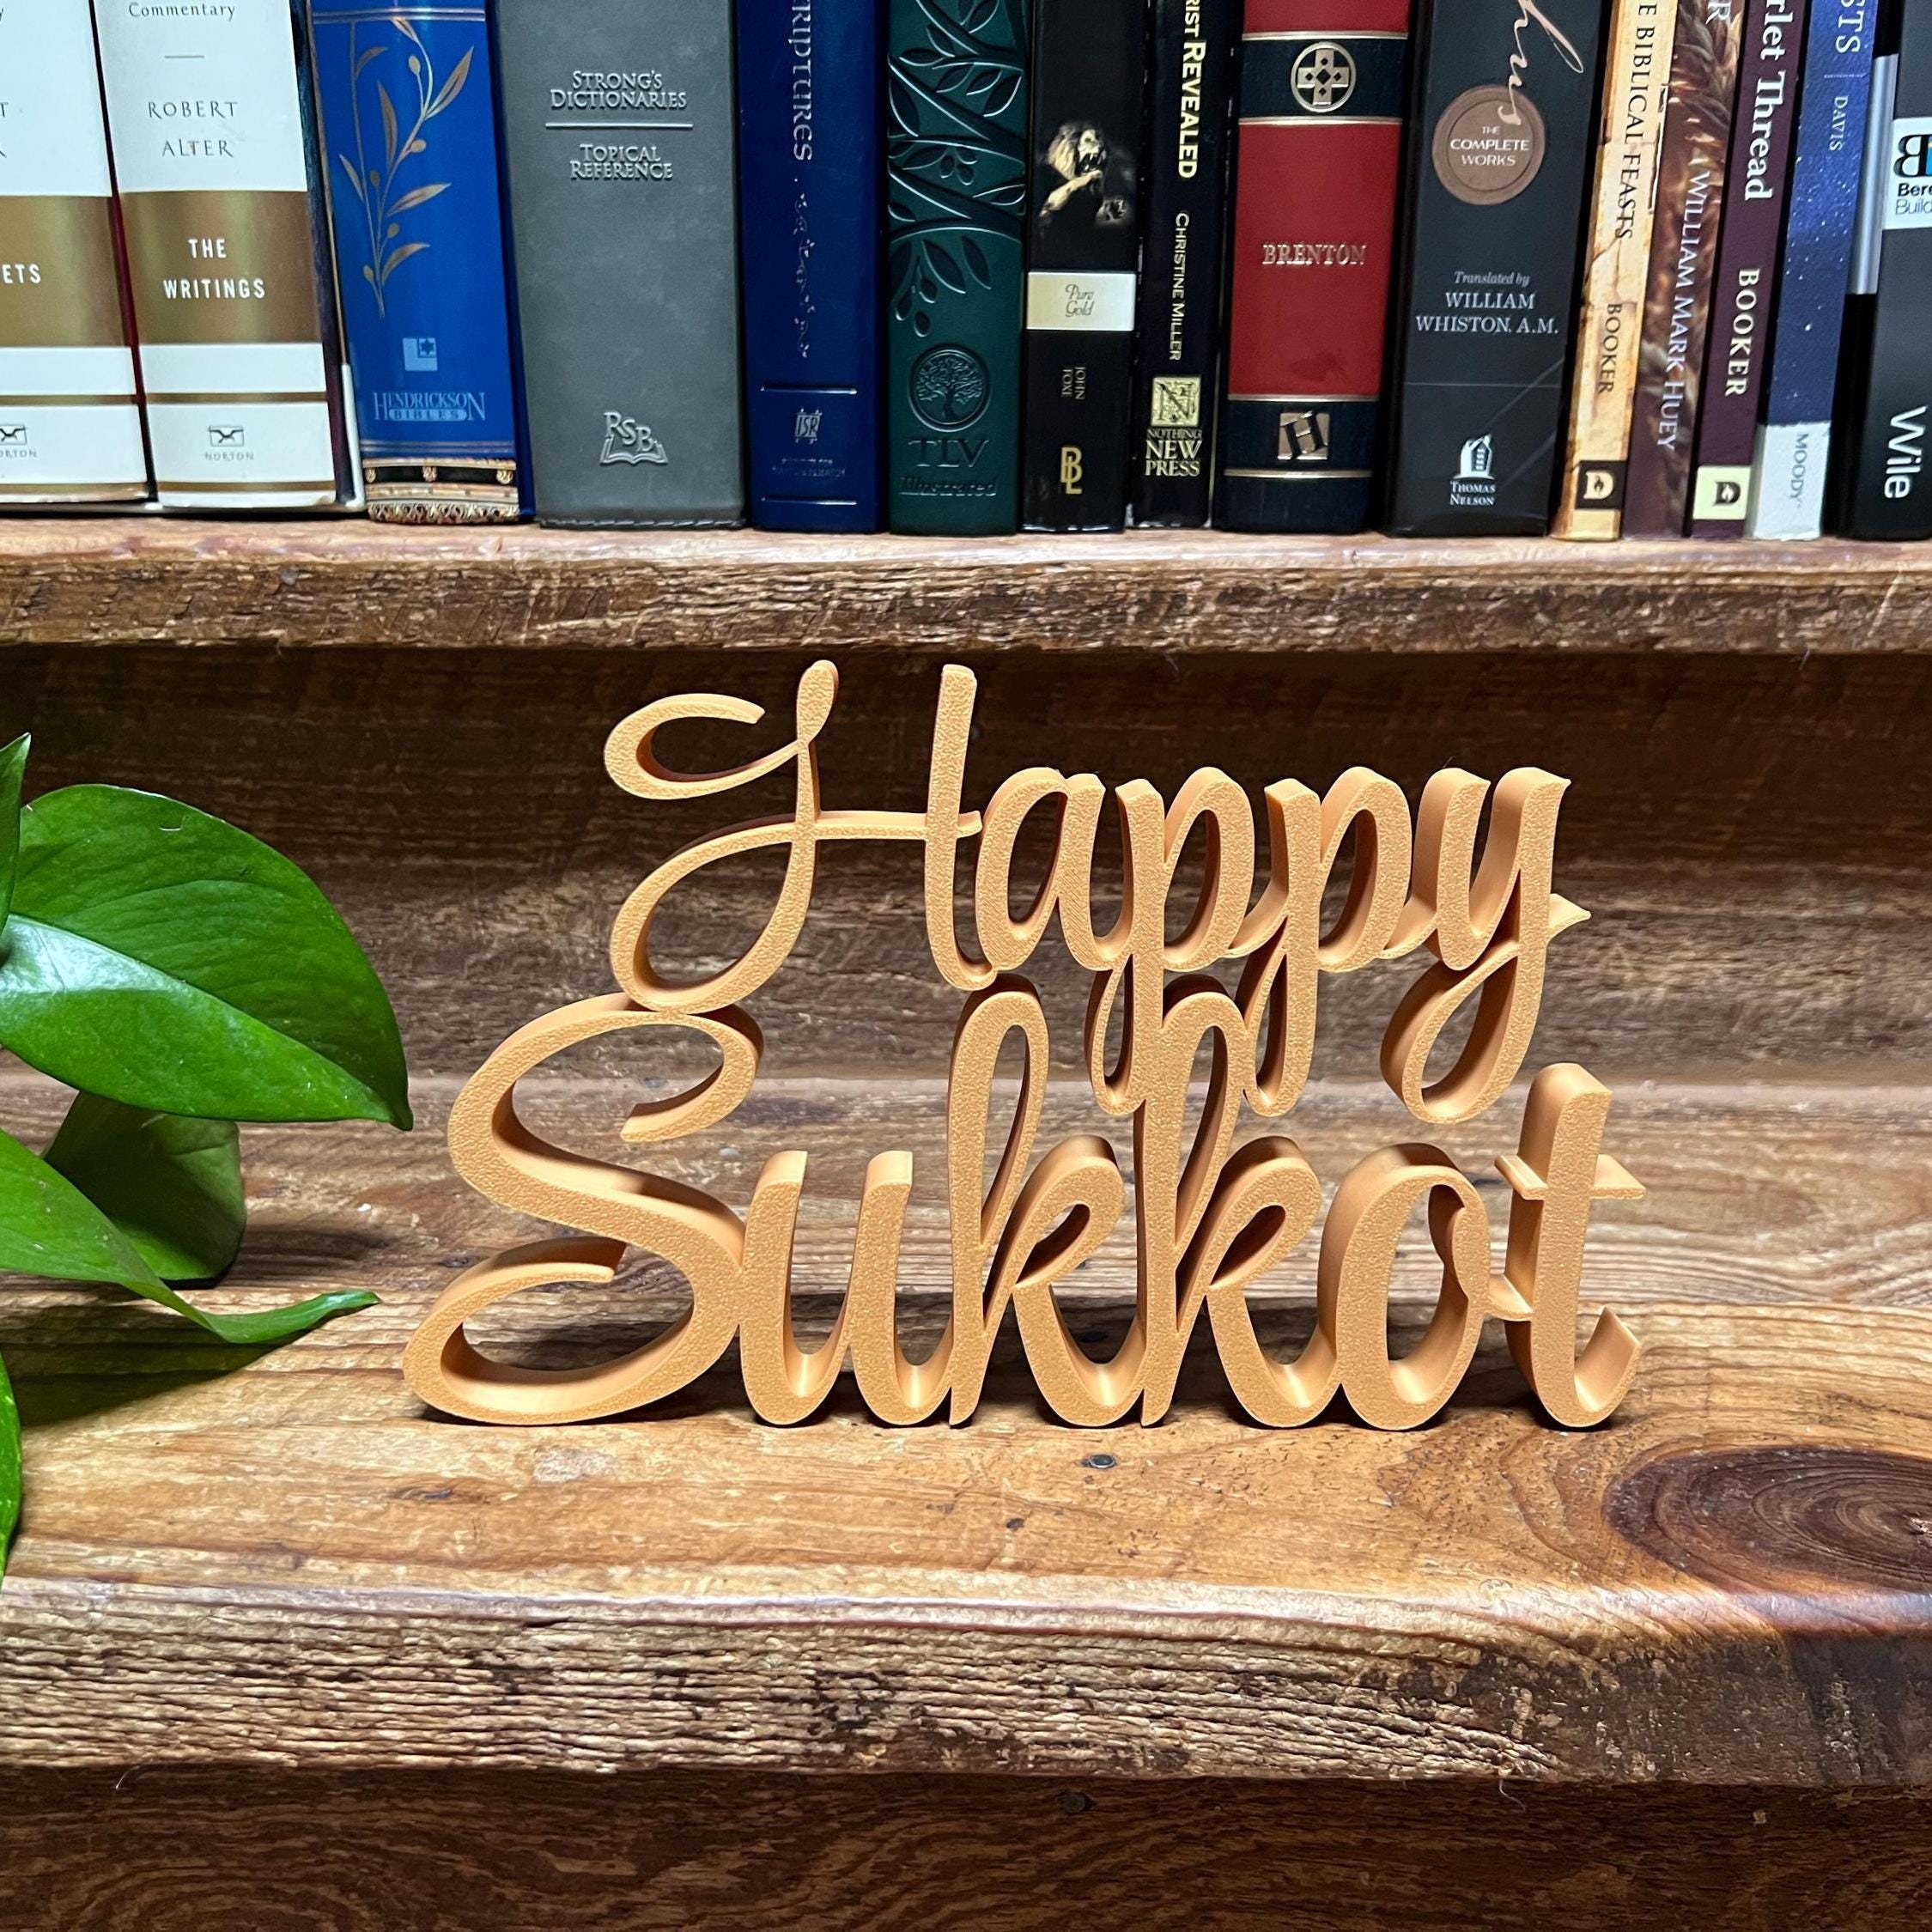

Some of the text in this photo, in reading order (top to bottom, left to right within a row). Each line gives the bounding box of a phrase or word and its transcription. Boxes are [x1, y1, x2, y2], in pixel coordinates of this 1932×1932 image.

[129, 3, 236, 21] Commentary
[572, 69, 663, 90] STRONG'S
[1624, 27, 1656, 145] BIBLICAL
[148, 101, 238, 119] ROBERT
[550, 89, 687, 110] DICTIONARIES
[1178, 41, 1207, 179] REVEALED
[1482, 125, 1500, 135] THE
[1830, 95, 1849, 151] DAVIS
[1449, 138, 1529, 152] COMPLETE
[1745, 70, 1787, 200] Thread
[161, 139, 234, 158] ALTER
[580, 144, 661, 162] TOPICAL
[570, 161, 673, 180] REFERENCE
[1461, 155, 1516, 167] WORKS
[1615, 153, 1641, 240] FEASTS
[188, 238, 228, 259] THE
[1262, 244, 1366, 265] BRENTON
[163, 278, 265, 300] WRITINGS
[1170, 212, 1191, 361] CHRISTINE MILLER
[1454, 271, 1530, 287] Translated by
[1065, 283, 1095, 301] Pure
[1445, 292, 1535, 310] WILLIAM
[1065, 301, 1096, 318] Gold
[1656, 171, 1710, 451] WILLIAM MARK HUEY
[1516, 318, 1558, 334] A.M.
[1725, 268, 1760, 397] BOOKER
[1598, 303, 1622, 393] BOOKER
[373, 392, 486, 421] HENDRICKSON
[604, 411, 655, 453] RSB
[1146, 428, 1202, 439] NOTHING
[204, 452, 254, 461] NORTON
[908, 438, 990, 467] TLV
[1145, 440, 1202, 459] NEW
[1884, 405, 1929, 499] Wile
[1145, 460, 1200, 477] PRESS
[1789, 433, 1809, 501] MOODY
[1449, 480, 1496, 493] THOMAS
[1449, 494, 1495, 506] NELSON
[604, 659, 1591, 1123] Happy
[404, 974, 1647, 1429] Sukkot
